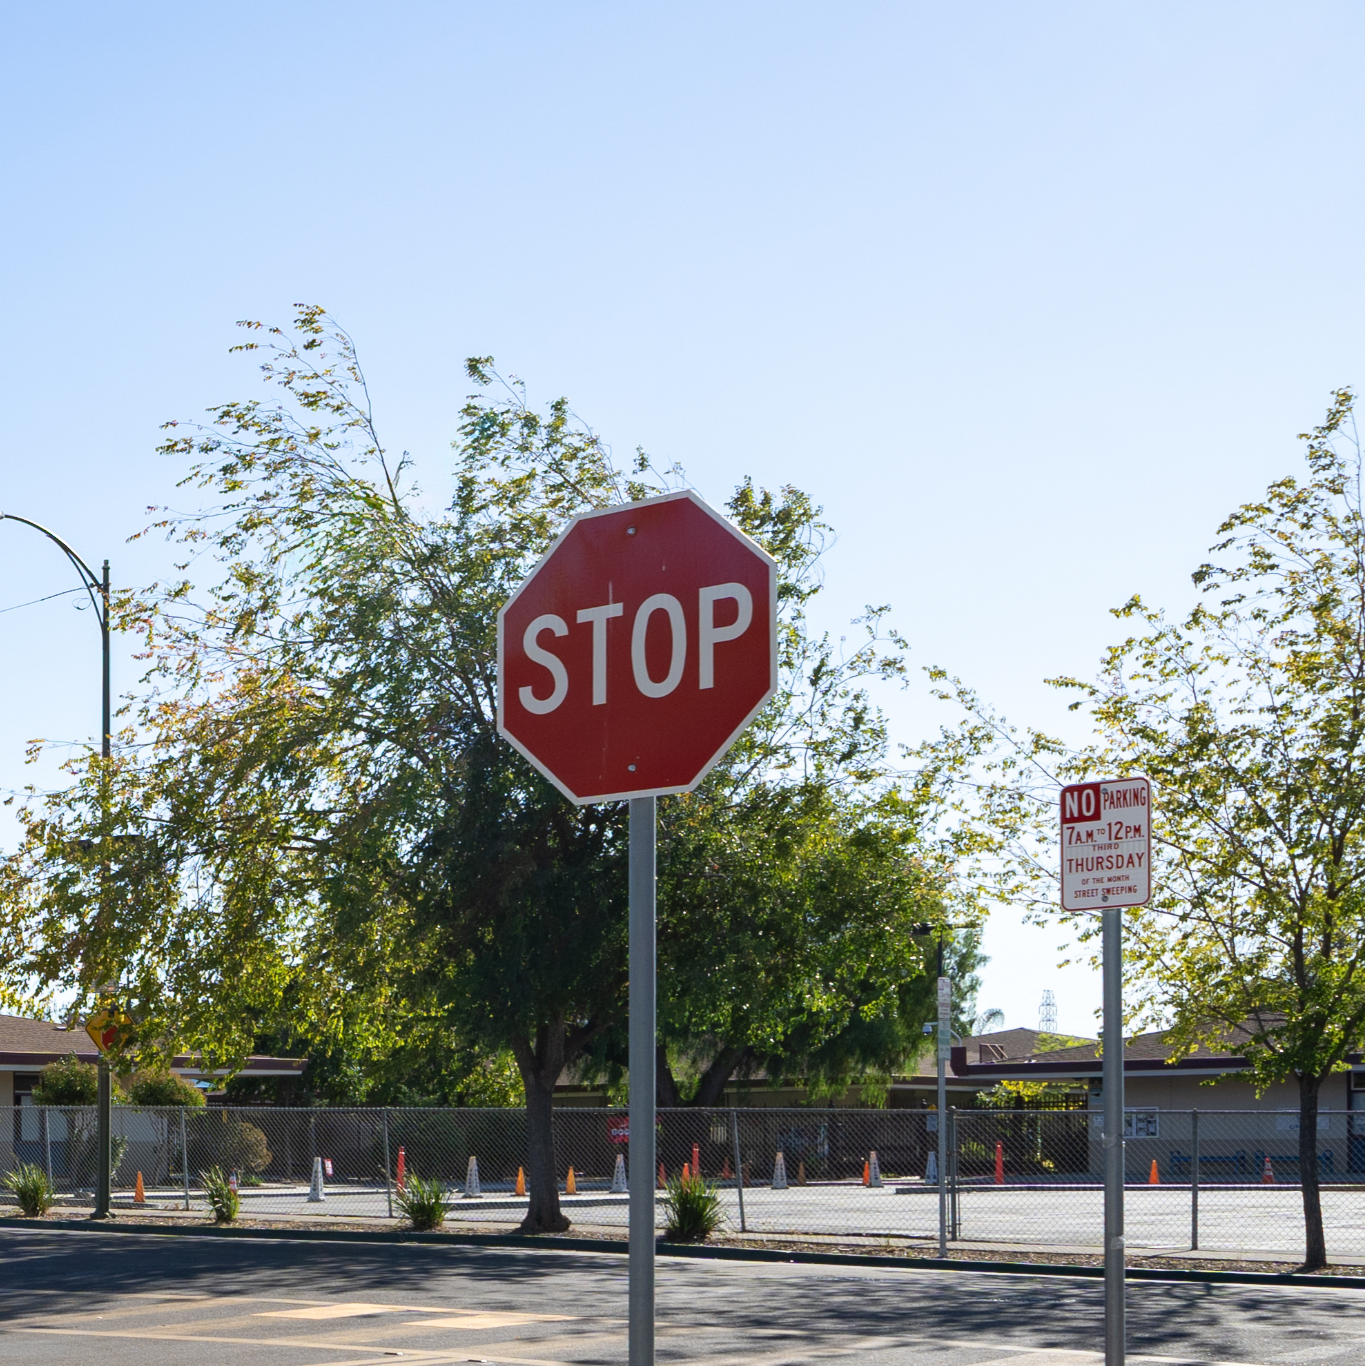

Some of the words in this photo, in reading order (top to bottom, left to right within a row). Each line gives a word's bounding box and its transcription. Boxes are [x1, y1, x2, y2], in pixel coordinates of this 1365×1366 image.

[518, 581, 754, 715] STOP
[1065, 788, 1095, 819] NO
[1103, 787, 1146, 810] PARKING
[1097, 828, 1106, 836] TO
[1092, 843, 1120, 852] THIRD
[1066, 852, 1145, 874] THURSDAY
[1107, 875, 1130, 883] MONTH
[1074, 888, 1099, 898] STREET
[1101, 885, 1138, 897] SWEEPING
